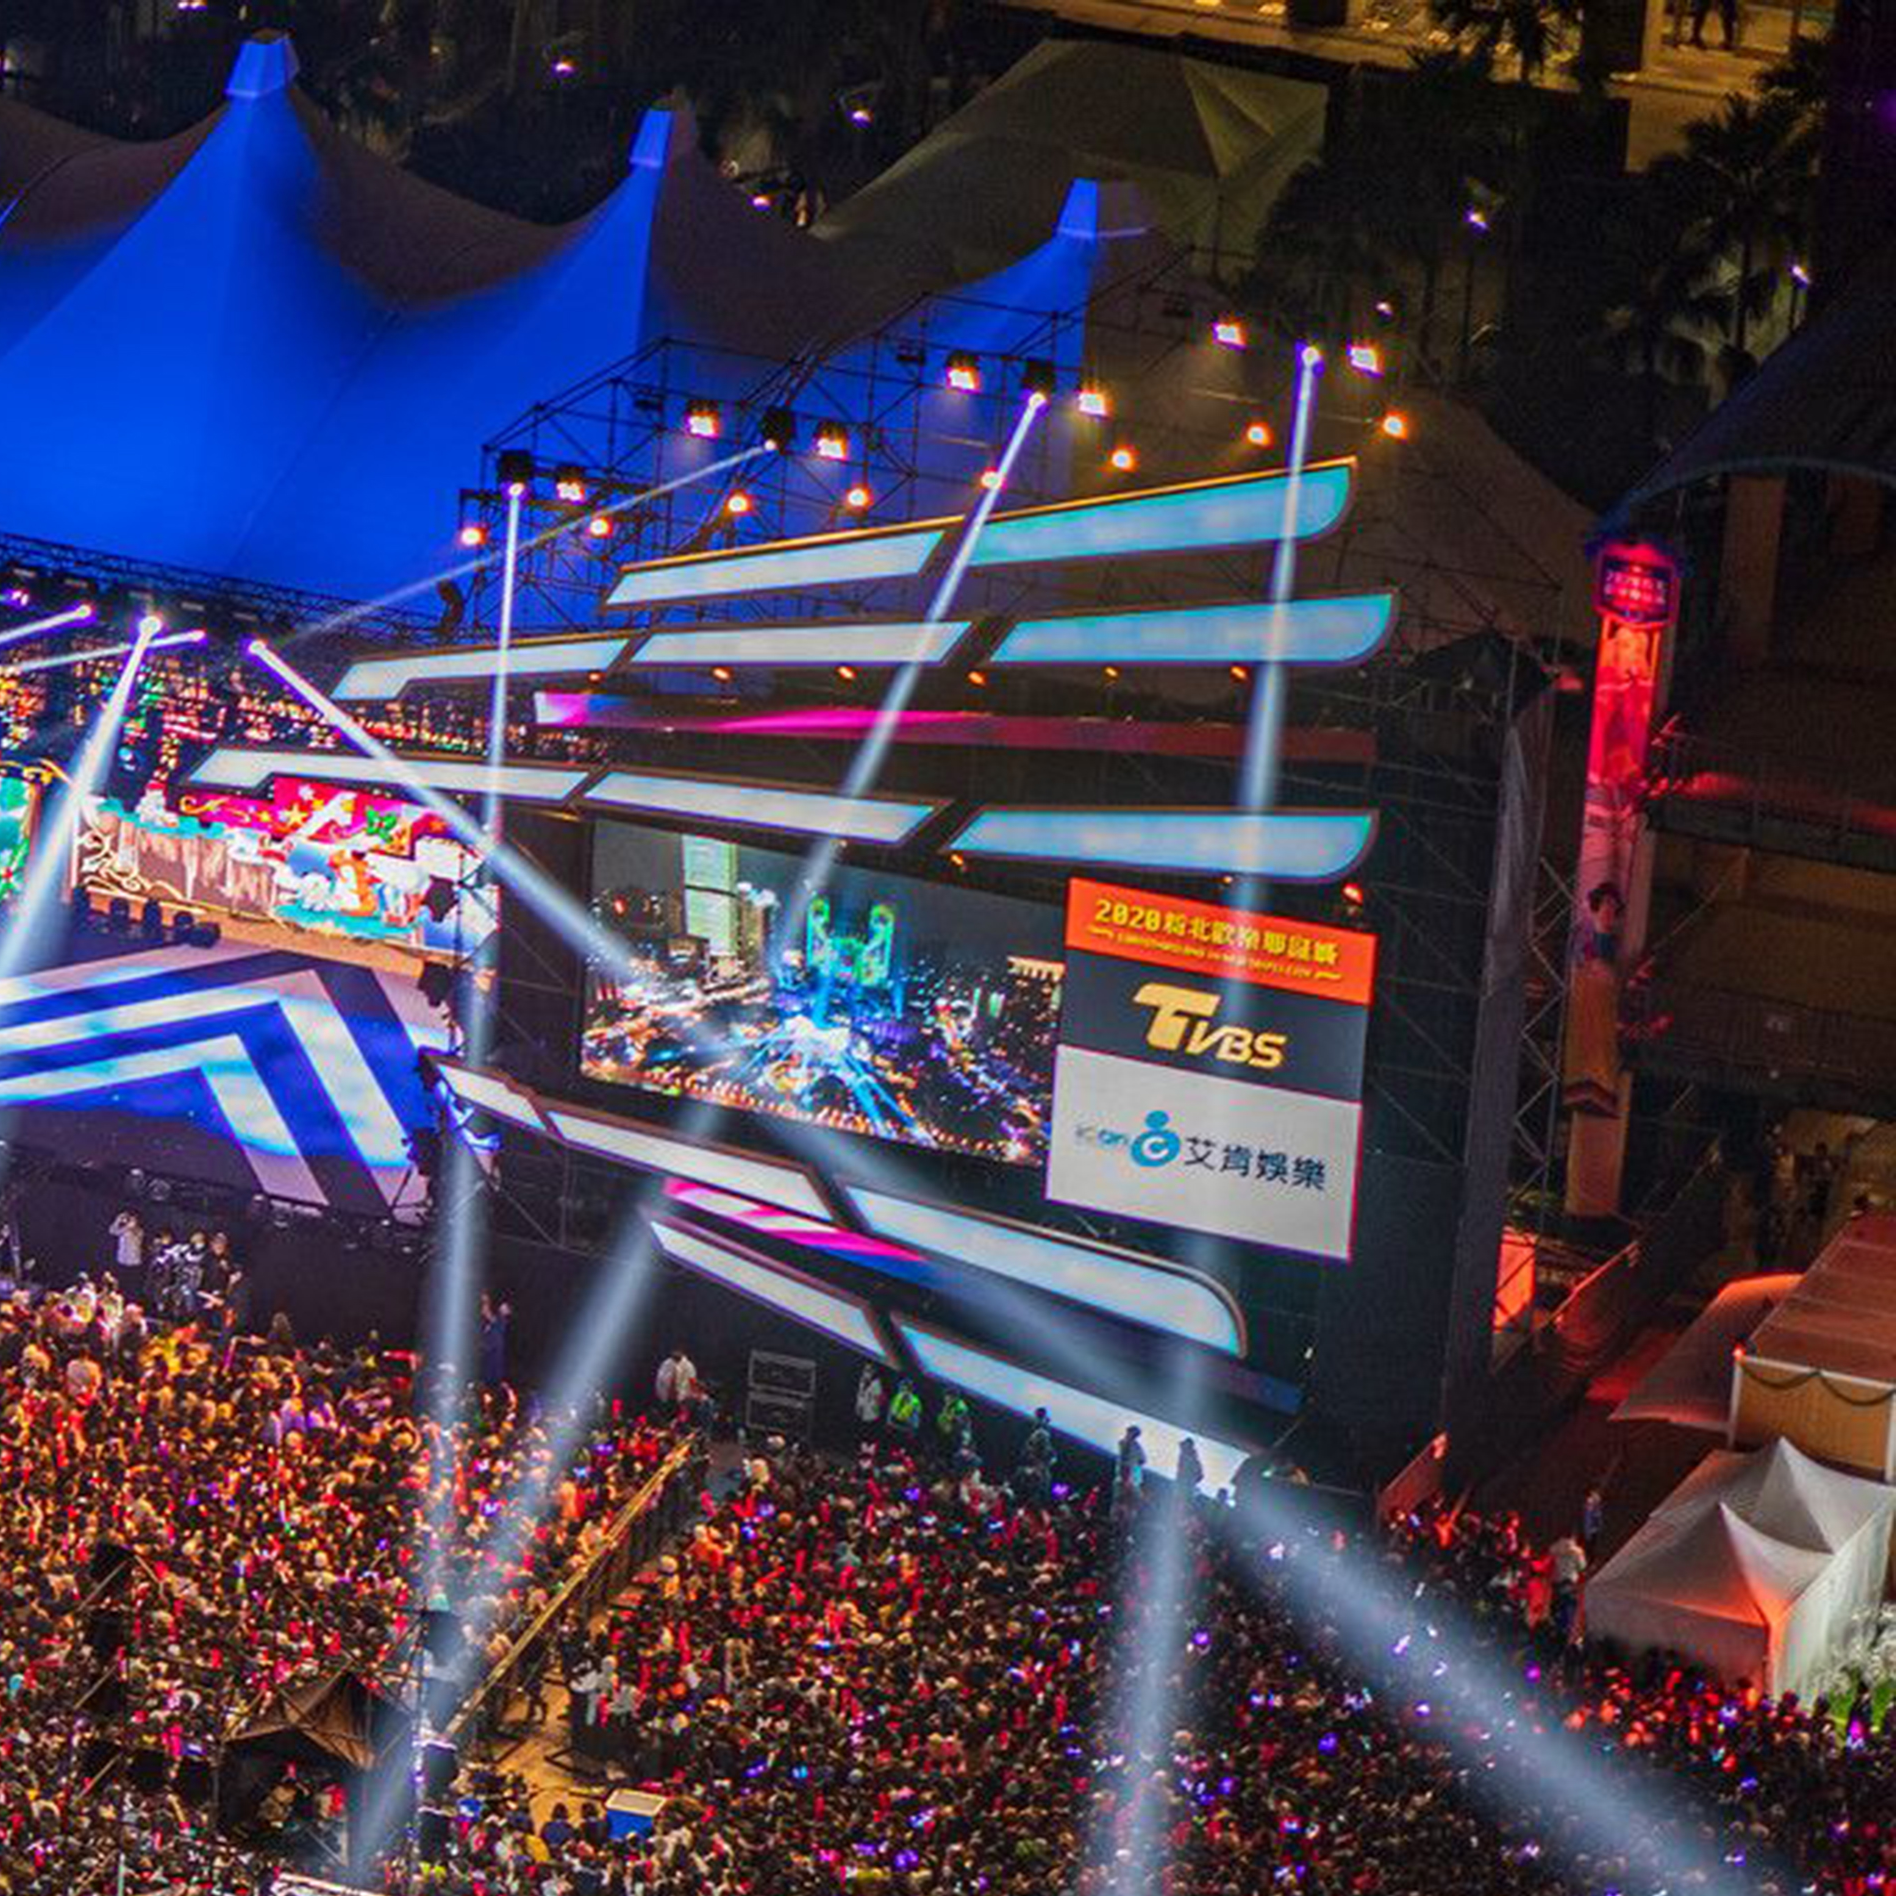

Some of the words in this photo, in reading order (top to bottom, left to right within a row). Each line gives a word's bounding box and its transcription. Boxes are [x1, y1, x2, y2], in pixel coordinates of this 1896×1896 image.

[1133, 982, 1288, 1069] TVBS
[1184, 1136, 1326, 1190] 艾肯娛樂
